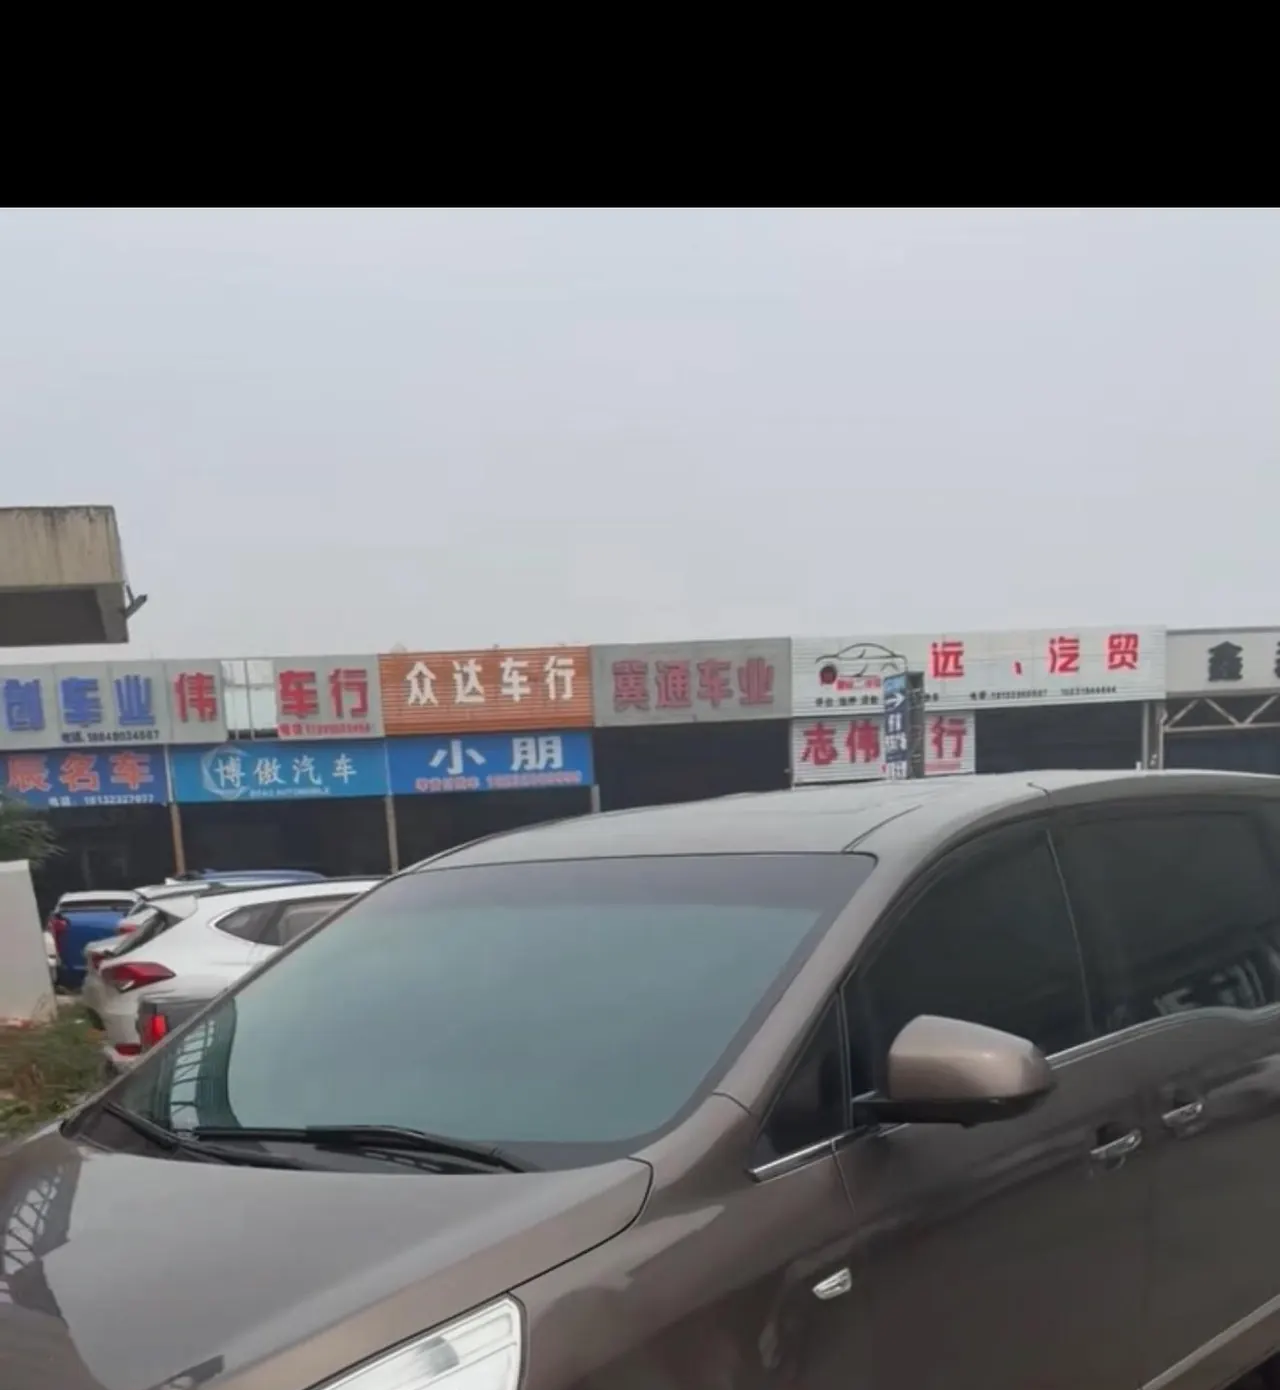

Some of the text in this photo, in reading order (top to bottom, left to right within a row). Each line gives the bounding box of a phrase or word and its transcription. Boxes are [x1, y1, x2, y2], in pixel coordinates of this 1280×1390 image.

[406, 655, 576, 707] 众达车行
[429, 736, 563, 775] 小朋
